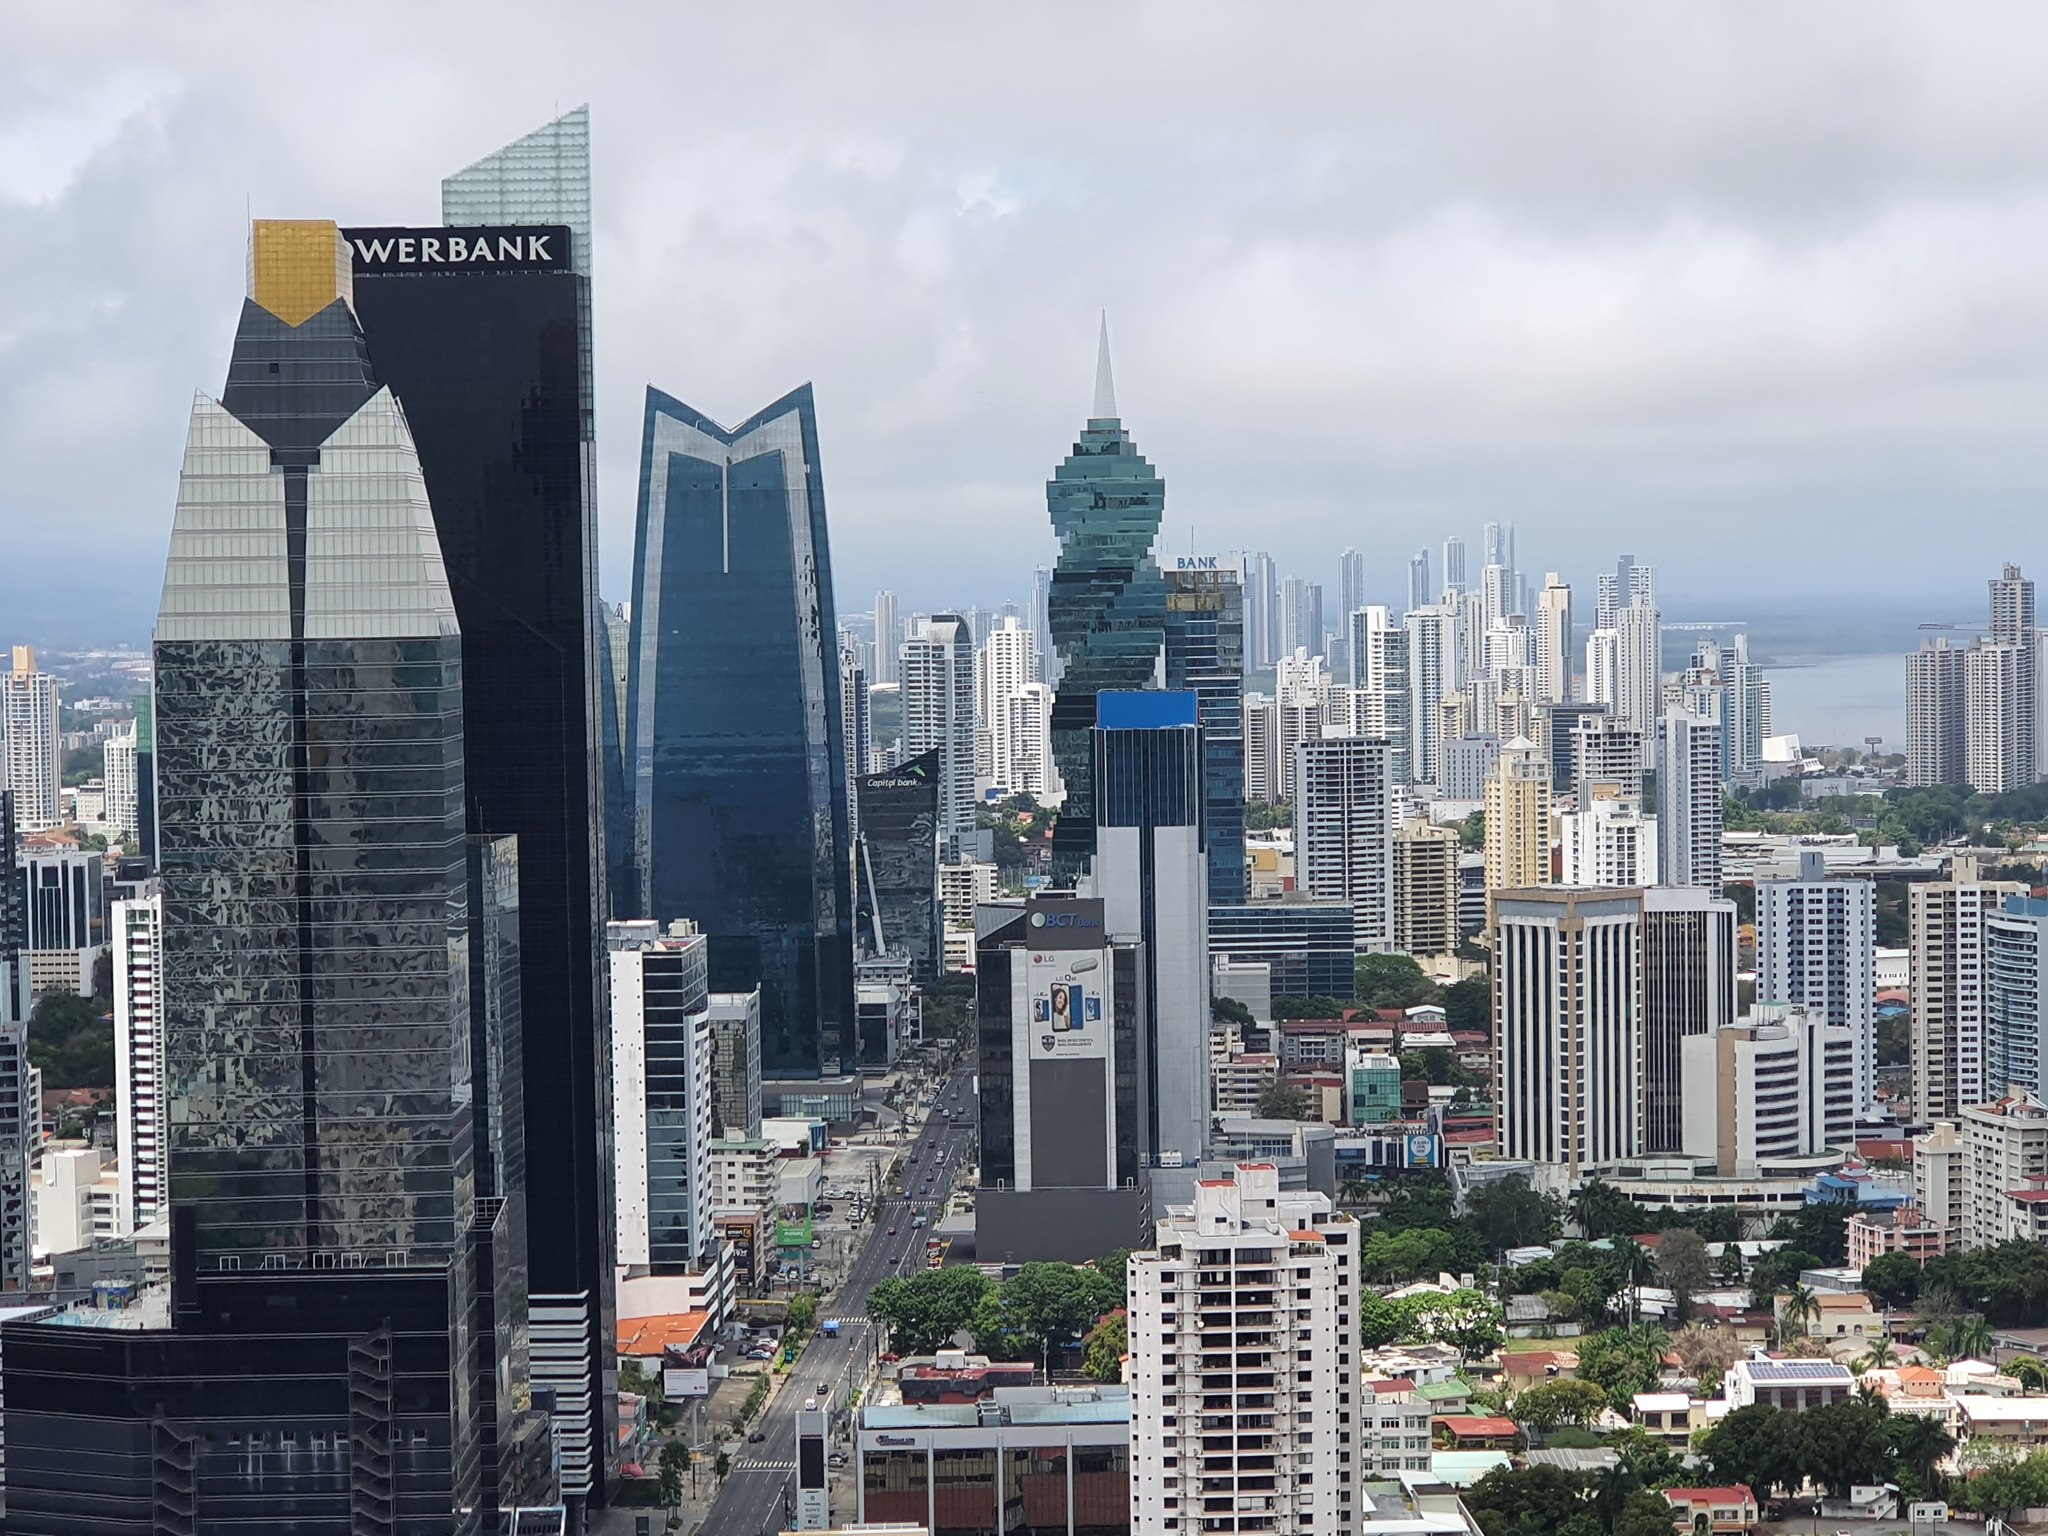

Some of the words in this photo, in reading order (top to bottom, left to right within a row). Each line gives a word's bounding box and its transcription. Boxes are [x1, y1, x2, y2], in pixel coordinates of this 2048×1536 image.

[347, 235, 554, 264] WERBANK
[1177, 556, 1217, 569] BANK
[868, 778, 896, 789] Capital
[898, 778, 918, 787] bank
[1046, 912, 1078, 927] BCT
[1079, 919, 1100, 927] Bank
[1043, 955, 1055, 963] LG
